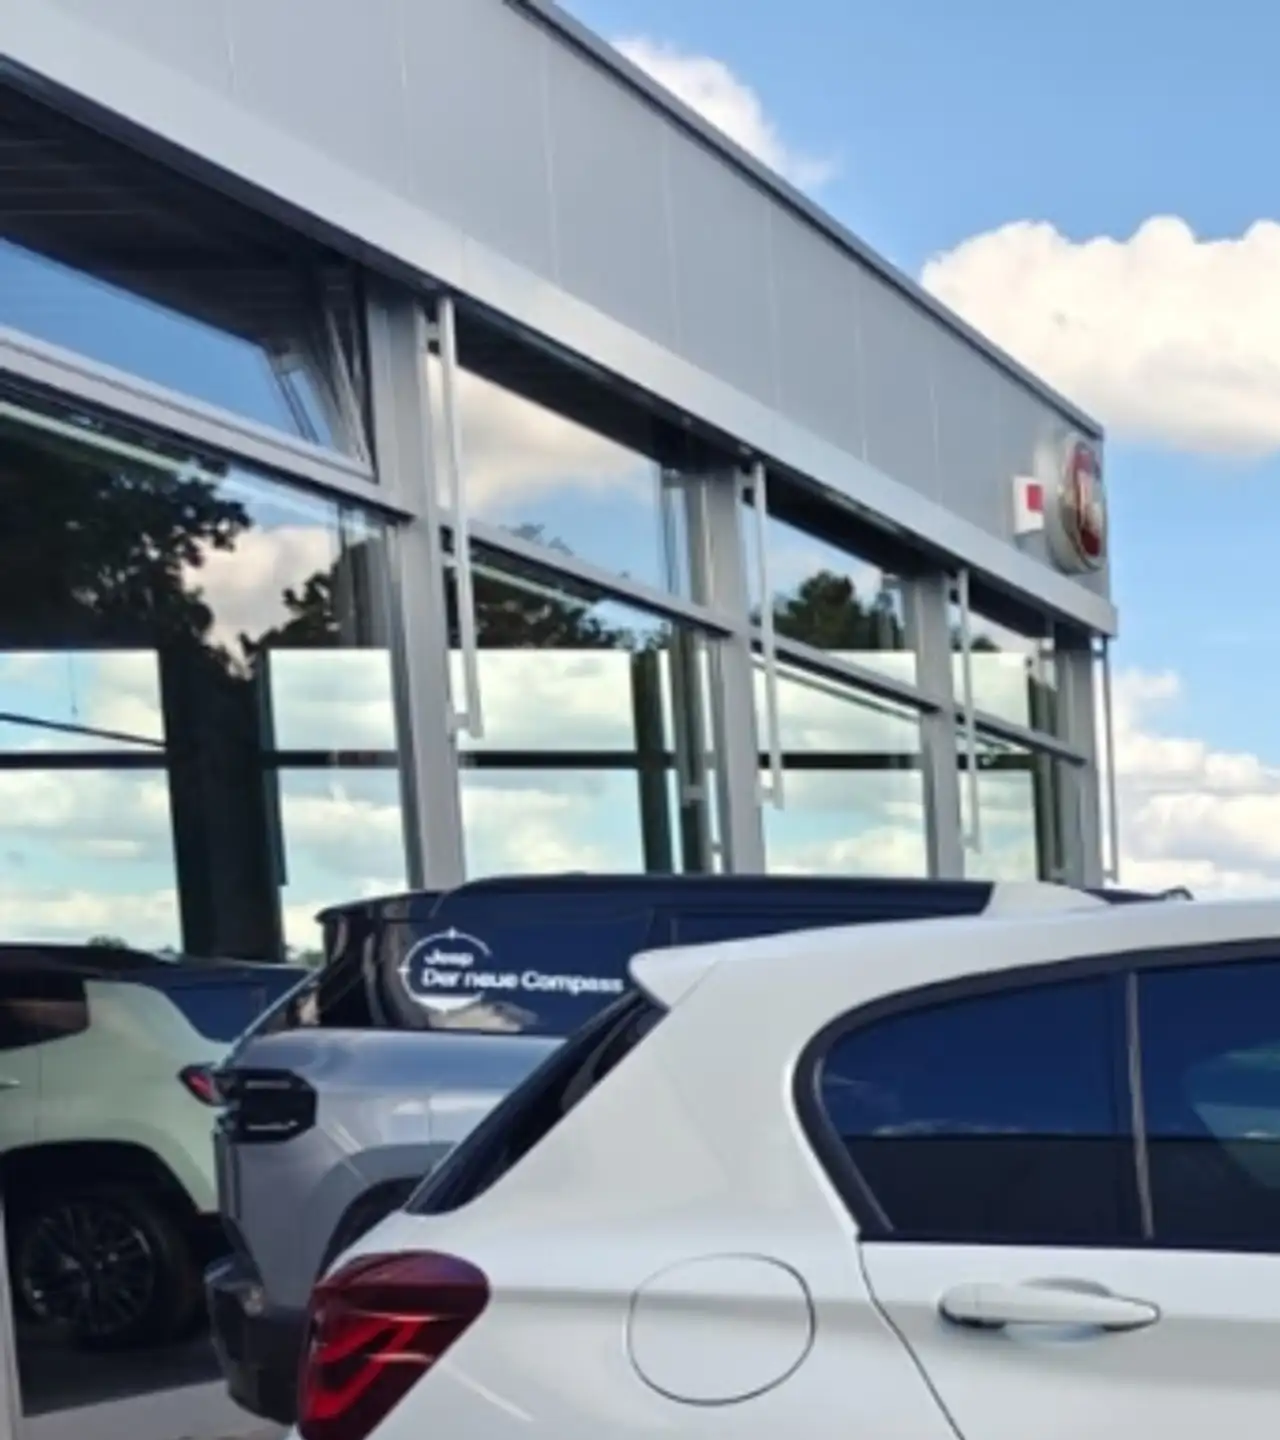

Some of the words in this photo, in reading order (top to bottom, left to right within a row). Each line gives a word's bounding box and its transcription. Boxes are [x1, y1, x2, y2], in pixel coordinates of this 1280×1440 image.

[423, 949, 474, 967] Jeep
[421, 969, 463, 988] Der
[464, 971, 519, 989] neue
[520, 970, 625, 996] Compass
